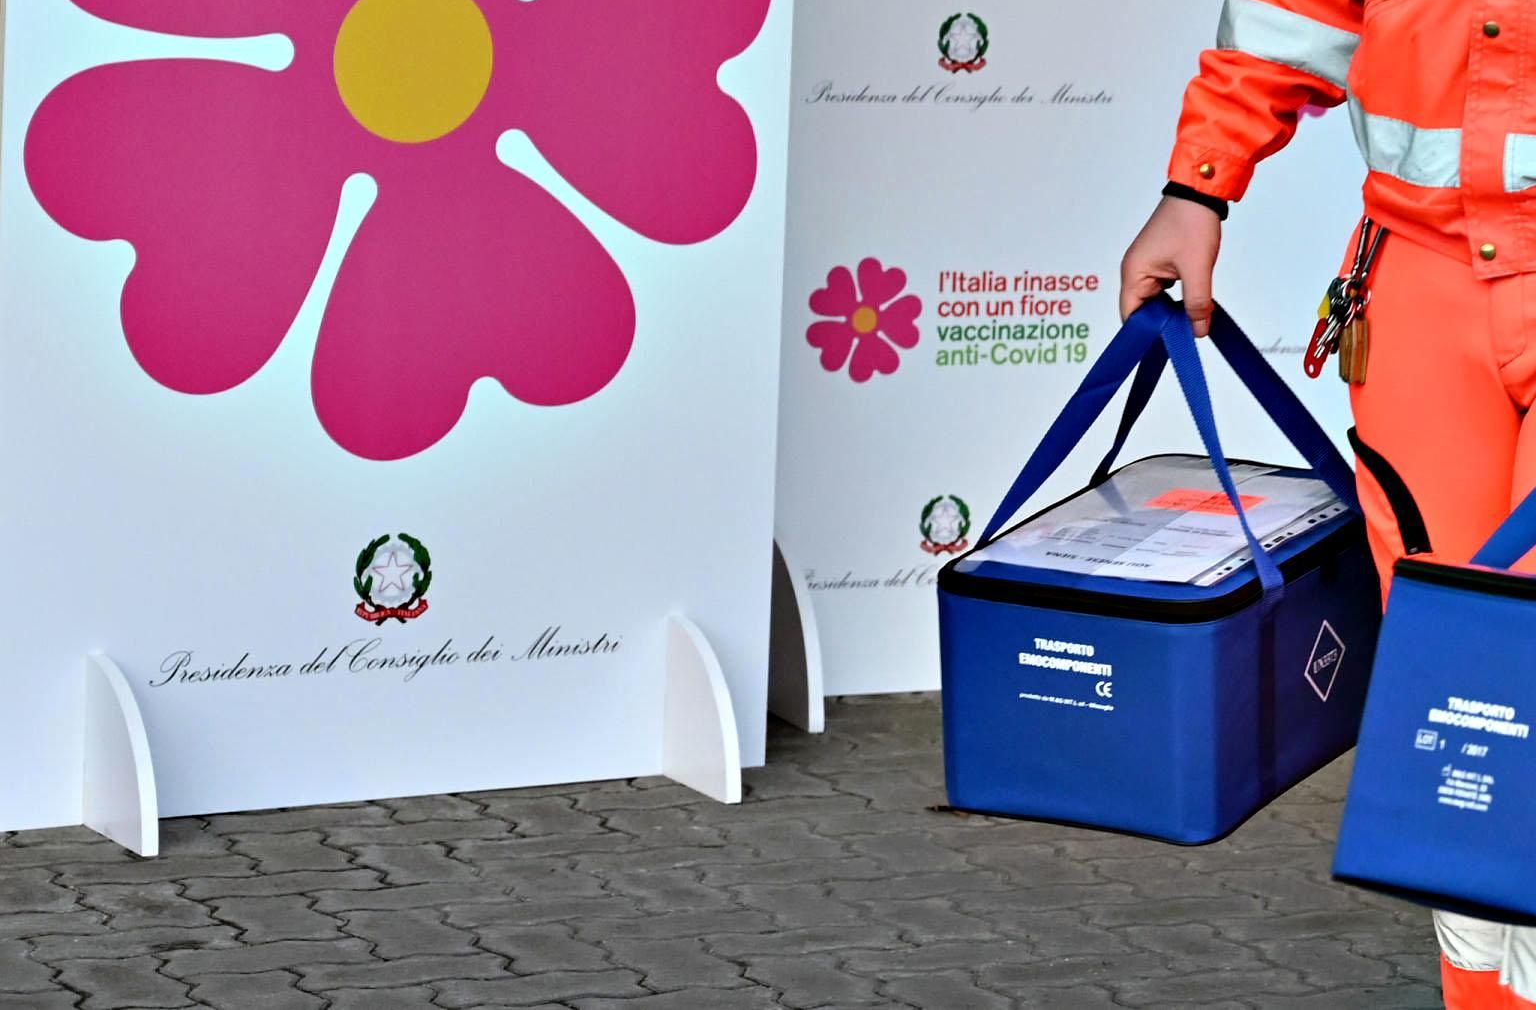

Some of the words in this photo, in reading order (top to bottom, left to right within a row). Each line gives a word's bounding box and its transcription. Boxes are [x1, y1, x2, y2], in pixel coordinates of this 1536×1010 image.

[938, 271, 1007, 293] l'Italia
[1013, 270, 1099, 292] rinasce
[937, 299, 980, 318] con
[985, 299, 1014, 316] un
[1020, 294, 1072, 316] fiore
[936, 319, 1090, 342] vaccinazione
[935, 343, 1057, 367] anti-Covid
[1065, 343, 1088, 363] 19
[149, 650, 291, 687] Presidenza
[300, 647, 347, 674] del
[347, 638, 460, 682] Consiglio
[467, 636, 503, 662] dei
[511, 626, 623, 660] Ministri
[1034, 638, 1094, 657] TRASPORTO
[1019, 652, 1112, 677] EMOCOMPONENTI
[1448, 696, 1515, 721] TRASPORTO
[1428, 708, 1529, 739] EMOCOMPONENTI
